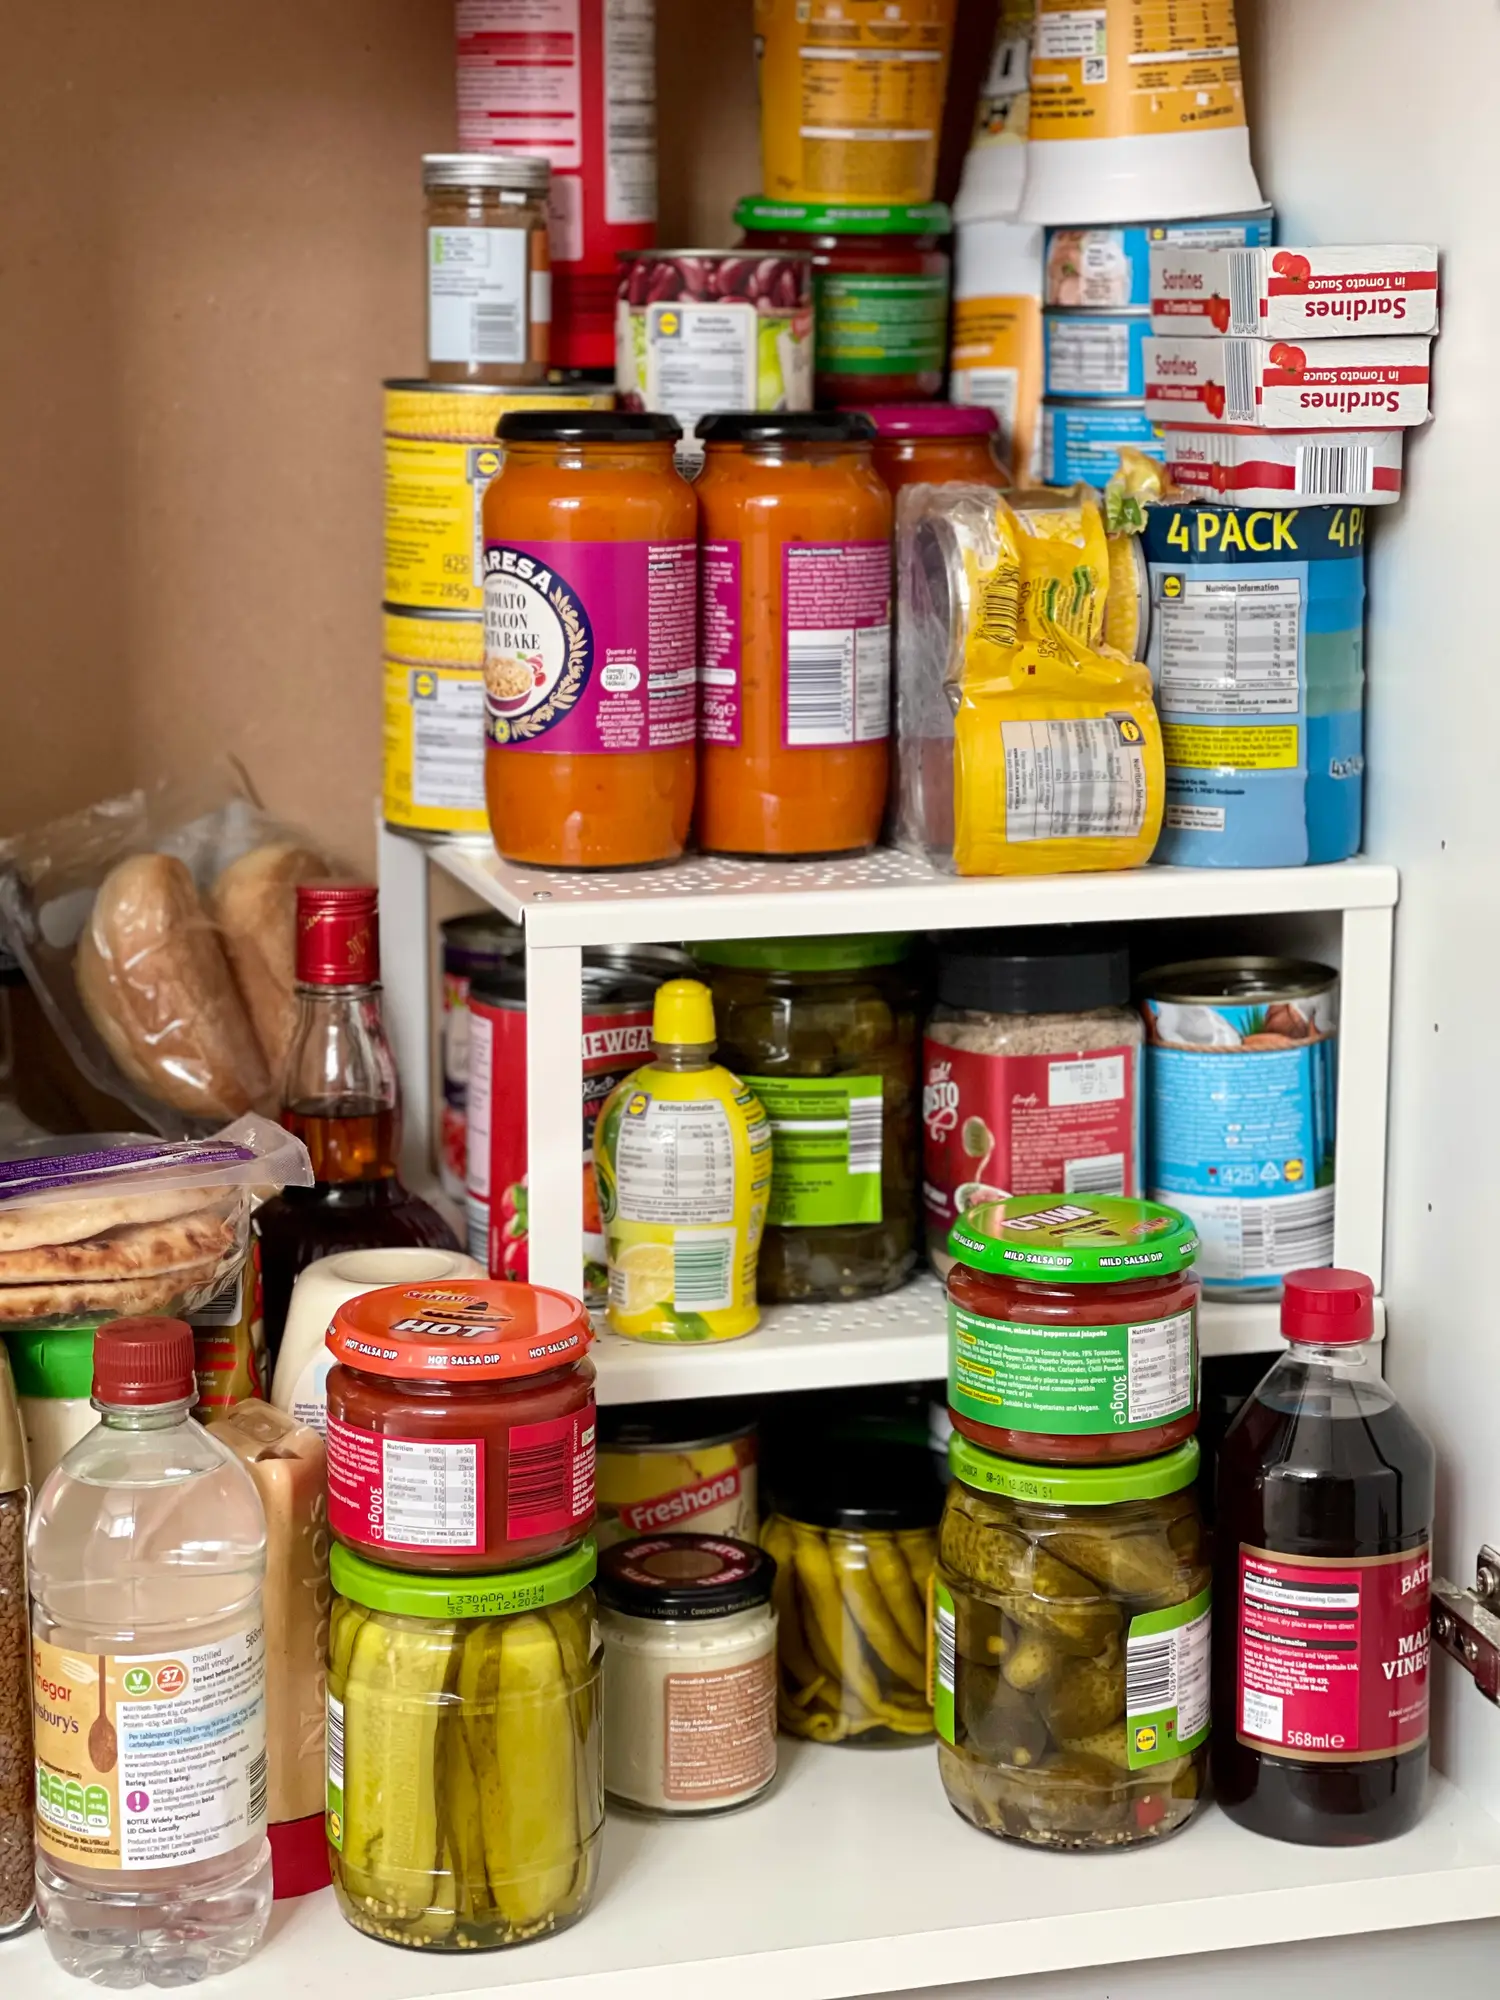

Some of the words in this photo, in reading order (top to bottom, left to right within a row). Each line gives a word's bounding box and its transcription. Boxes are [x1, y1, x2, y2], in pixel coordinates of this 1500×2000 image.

[1162, 269, 1203, 290] Sardines
[1308, 280, 1343, 291] Sauce
[1346, 276, 1391, 289] Tomato
[1394, 276, 1406, 288] in
[1305, 297, 1406, 321] Sardines
[1156, 354, 1198, 376] Sardines
[1303, 372, 1337, 384] Sauce
[1340, 371, 1385, 383] Tomato
[1388, 371, 1399, 382] in
[1300, 391, 1399, 412] Sardines
[1166, 512, 1189, 552] 4
[1197, 510, 1299, 552] PACK
[1328, 508, 1345, 548] 4
[1238, 583, 1279, 592] Information
[491, 611, 528, 629] BACON
[504, 633, 540, 650] BAKE
[1133, 758, 1143, 789] Nutrition
[1001, 1205, 1098, 1230] MILD
[973, 1242, 985, 1252] DIP
[1004, 1250, 1024, 1262] MILD
[1026, 1253, 1054, 1265] SALSA
[1056, 1256, 1073, 1267] DIP
[1099, 1256, 1123, 1267] MILD
[1123, 1254, 1150, 1265] SALSA
[1151, 1252, 1164, 1263] DIP
[393, 1318, 497, 1338] HOT
[1132, 1327, 1155, 1335] Nutrition
[345, 1339, 358, 1350] HOT
[359, 1343, 381, 1358] SALSA
[383, 1349, 398, 1360] DIP
[529, 1347, 546, 1359] HOT
[546, 1340, 569, 1355] SALSA
[569, 1336, 579, 1349] DIP
[428, 1355, 448, 1365] HOT
[451, 1355, 481, 1365] SALSA
[484, 1354, 500, 1365] DIP
[1033, 1403, 1065, 1411] Vegetarians
[387, 1444, 413, 1452] Nutrition
[631, 1475, 736, 1529] Freshona
[1245, 1559, 1256, 1569] Malt
[1257, 1564, 1278, 1574] vinegar
[1245, 1571, 1263, 1583] Allergy
[1263, 1577, 1282, 1587] Advice
[512, 1585, 545, 1599] 16:14
[1246, 1583, 1255, 1592] May
[1275, 1590, 1294, 1600] Cereals
[1295, 1594, 1326, 1604] containing
[472, 1597, 544, 1613] 31.12.2024
[1245, 1598, 1263, 1610] Storage
[1264, 1603, 1299, 1616] Instructions
[1245, 1609, 1257, 1618] Store
[1267, 1616, 1280, 1624] cool,
[1281, 1617, 1290, 1628] dry
[1291, 1619, 1307, 1630] place
[1308, 1622, 1323, 1631] away
[1323, 1621, 1337, 1630] from
[1338, 1621, 1355, 1630] direct
[1244, 1627, 1271, 1641] Additional
[1271, 1635, 1307, 1647] Information
[192, 1648, 222, 1664] Distilled
[1245, 1639, 1263, 1650] Suitable
[1272, 1646, 1304, 1658] Vegetarians
[1316, 1652, 1339, 1661] Vegans.
[193, 1663, 210, 1673] malt
[211, 1654, 235, 1668] vinegar
[1244, 1649, 1253, 1657] Lidl
[1265, 1655, 1282, 1665] GmbH
[1308, 1662, 1325, 1670] Great
[132, 1673, 143, 1685] V
[162, 1669, 179, 1683] 37
[193, 1676, 202, 1684] For
[202, 1673, 215, 1681] best
[215, 1668, 230, 1678] before
[1310, 1684, 1328, 1692] Road,
[139, 1729, 173, 1740] tablespoon
[222, 1751, 237, 1762] Barley
[153, 1788, 174, 1796] Allergy
[202, 1795, 215, 1804] bold
[127, 1818, 149, 1826] BOTTLE
[151, 1815, 173, 1824] Widely
[174, 1811, 200, 1821] Recycled
[138, 1826, 157, 1834] Check
[158, 1824, 180, 1833] Locally
